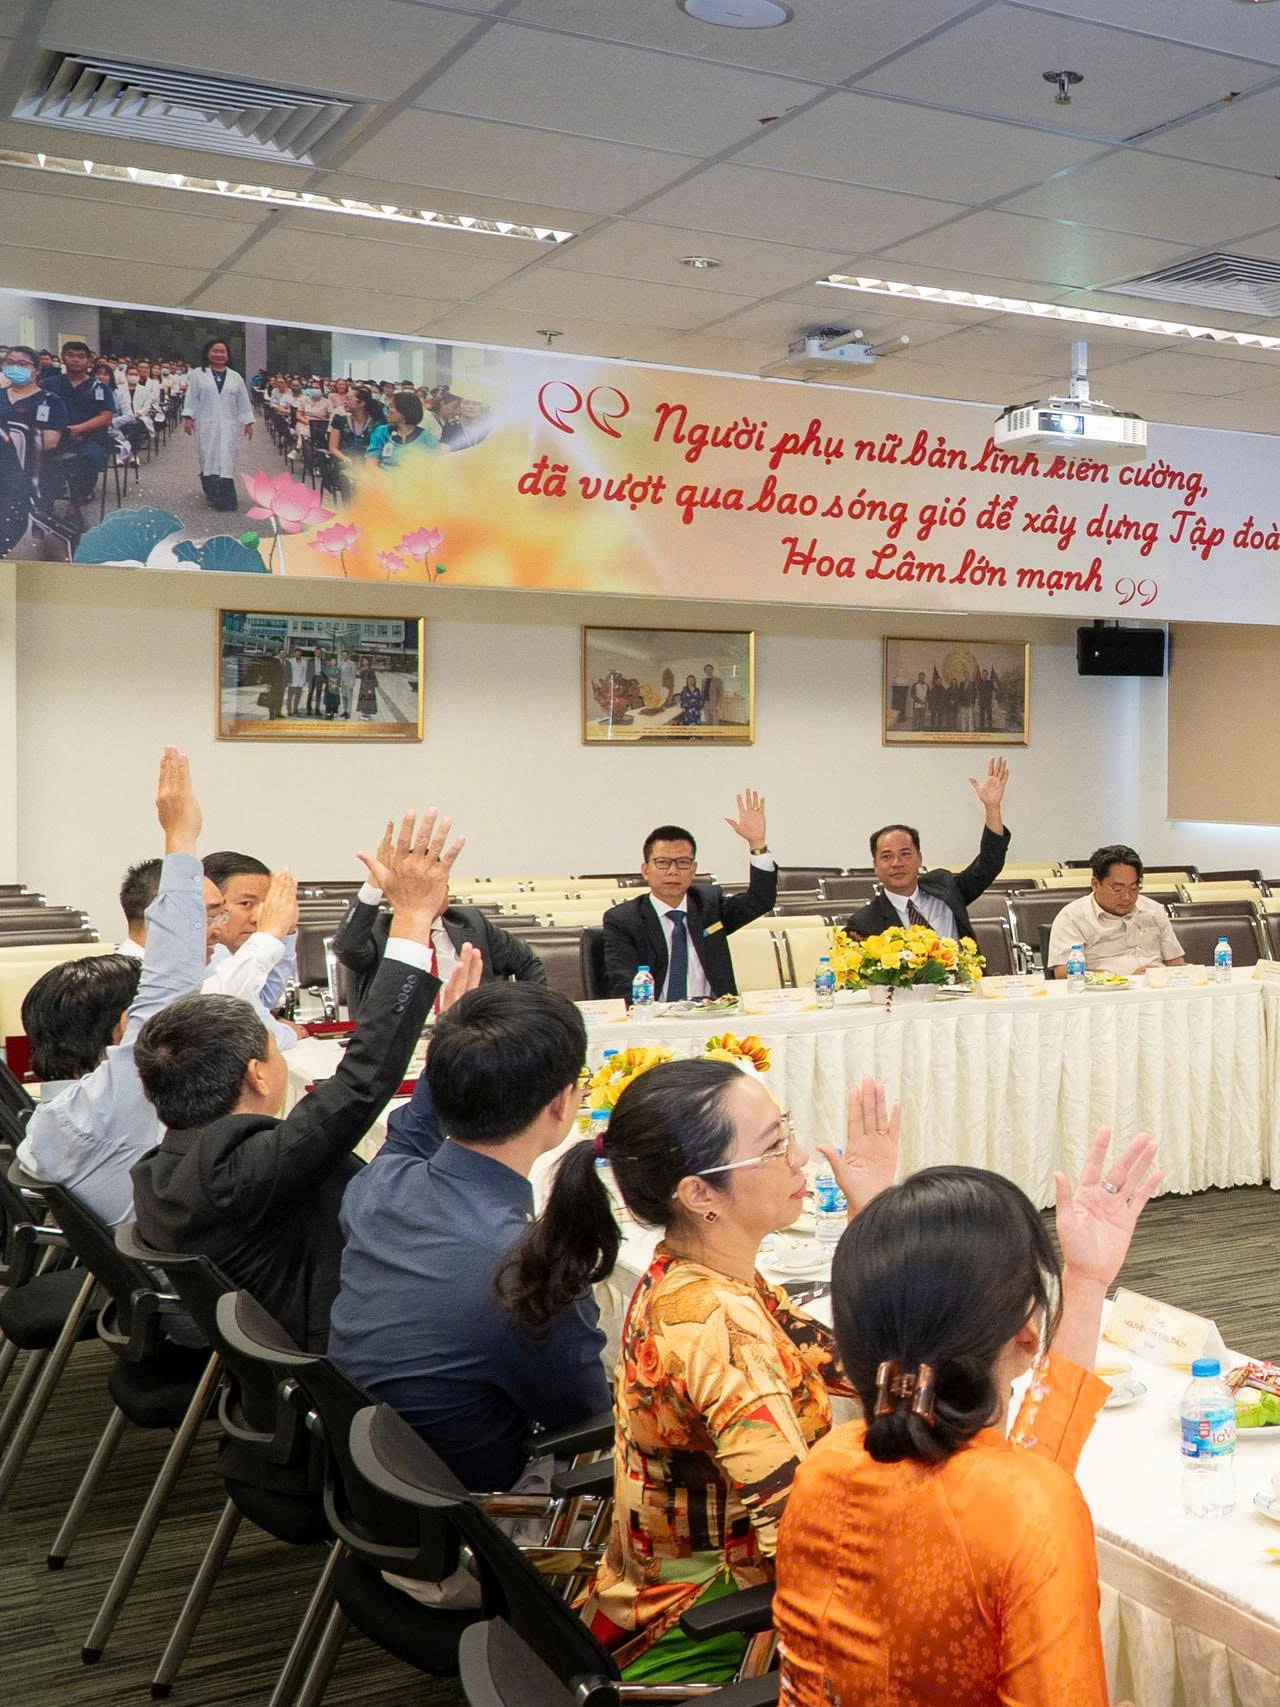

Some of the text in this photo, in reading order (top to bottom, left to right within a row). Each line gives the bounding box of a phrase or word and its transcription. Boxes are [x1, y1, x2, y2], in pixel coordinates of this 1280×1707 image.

[653, 403, 767, 463] Người
[769, 418, 844, 470] phụ
[854, 433, 902, 465] nữ
[902, 430, 967, 472] bản
[1119, 459, 1208, 506] cường,
[518, 455, 569, 496] đã
[579, 475, 666, 510] vượt
[676, 484, 744, 525] qua
[747, 475, 817, 515] bao
[821, 489, 908, 538] sóng
[918, 497, 966, 541] gió
[976, 494, 1018, 530] để
[1023, 504, 1078, 551] xây
[1086, 504, 1159, 557] dựng
[1169, 510, 1225, 560] Tập
[781, 536, 1103, 597] Hoa Lâm lớn mạnh
